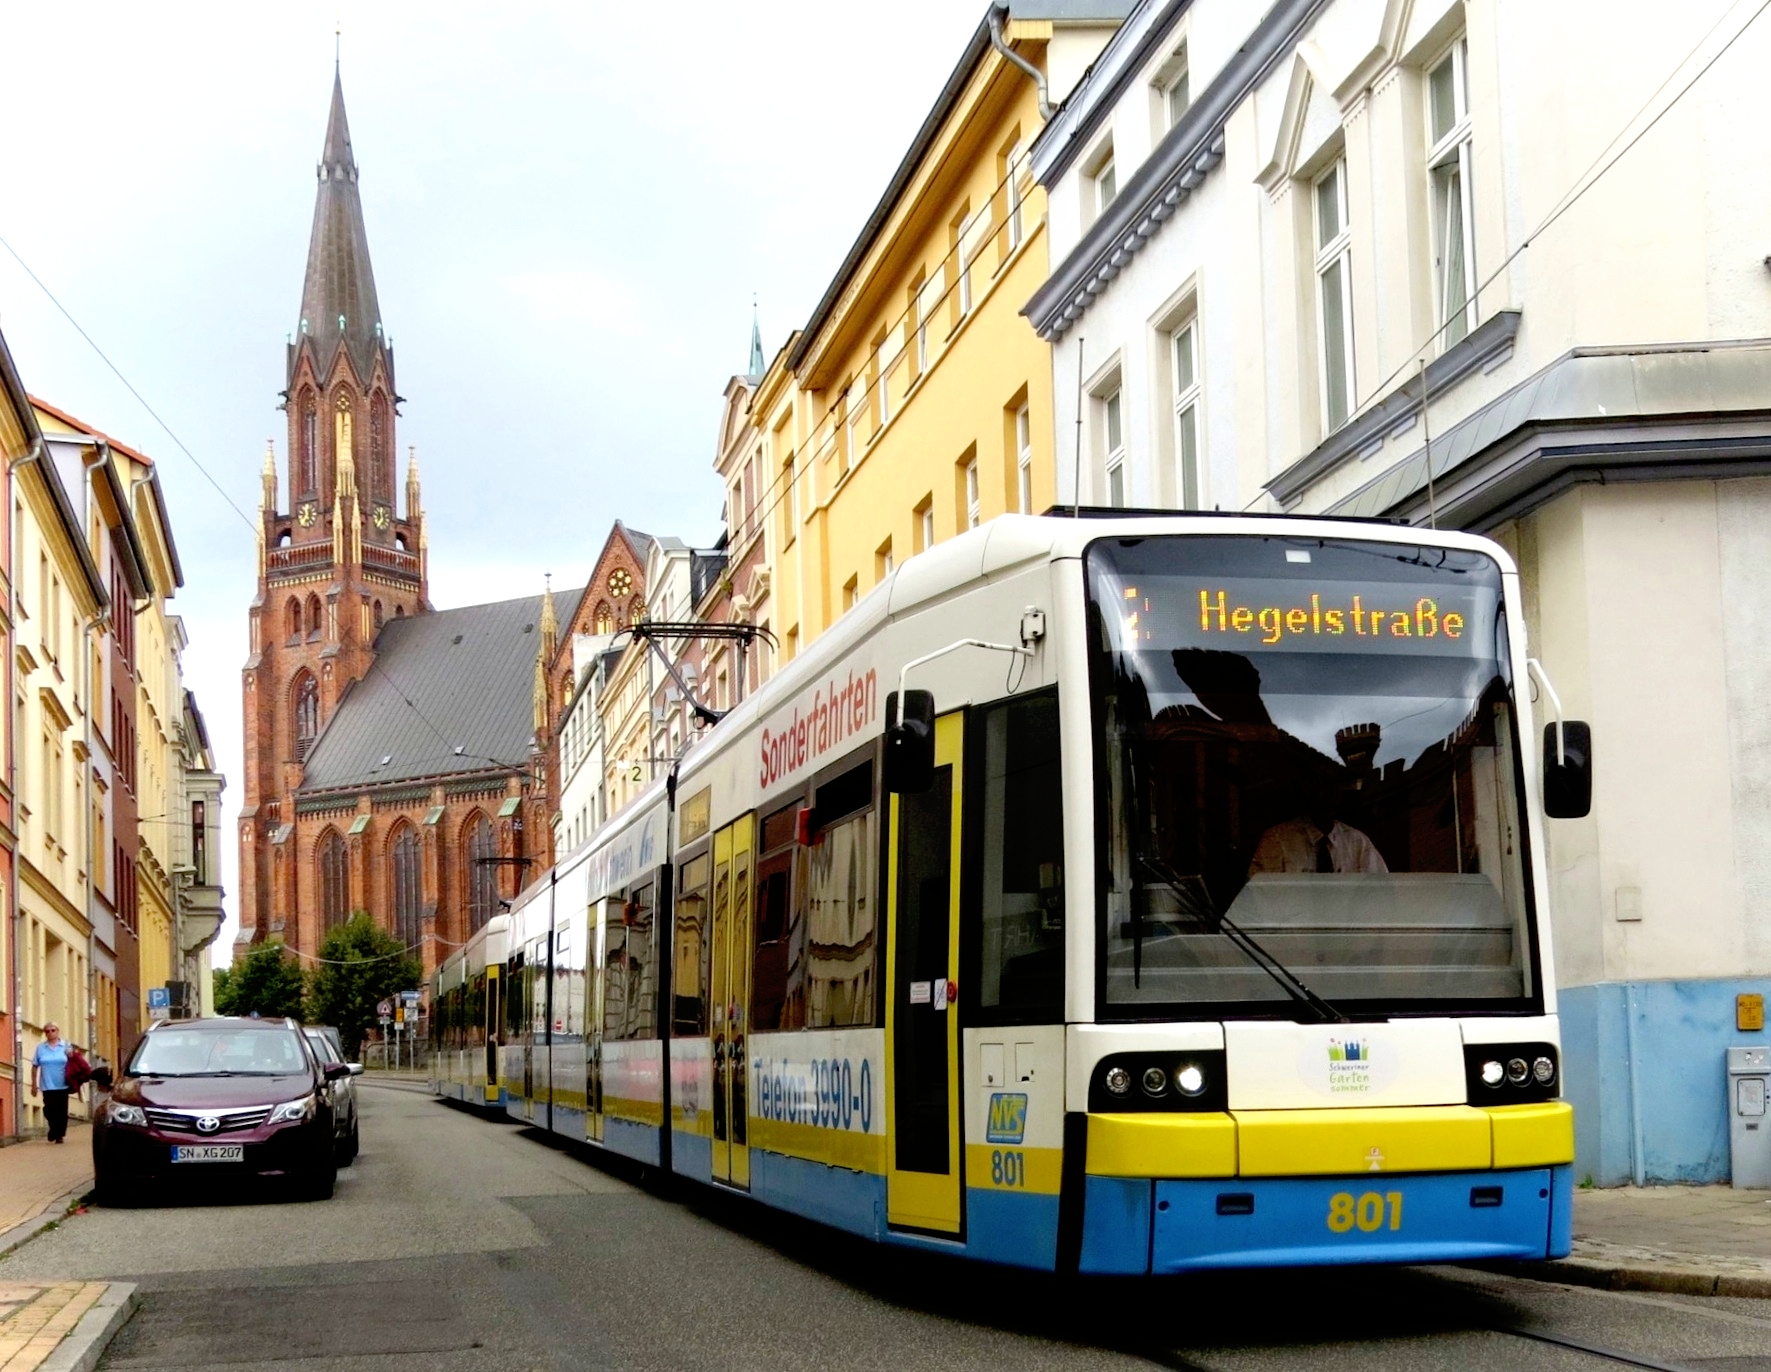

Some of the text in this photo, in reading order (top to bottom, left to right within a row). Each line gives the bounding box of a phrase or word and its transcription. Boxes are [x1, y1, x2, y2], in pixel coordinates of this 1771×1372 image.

[1200, 590, 1464, 643] Hegelstraße
[760, 667, 877, 790] Sonderfahrten
[632, 766, 642, 782] 2
[153, 990, 165, 1006] P
[1329, 1062, 1369, 1071] Schweriner
[1329, 1072, 1369, 1083] Garten
[753, 1057, 871, 1134] Telefon 3990-0
[180, 1148, 242, 1158] SN XG 207
[992, 1149, 1024, 1187] 801
[1327, 1191, 1403, 1233] 801
